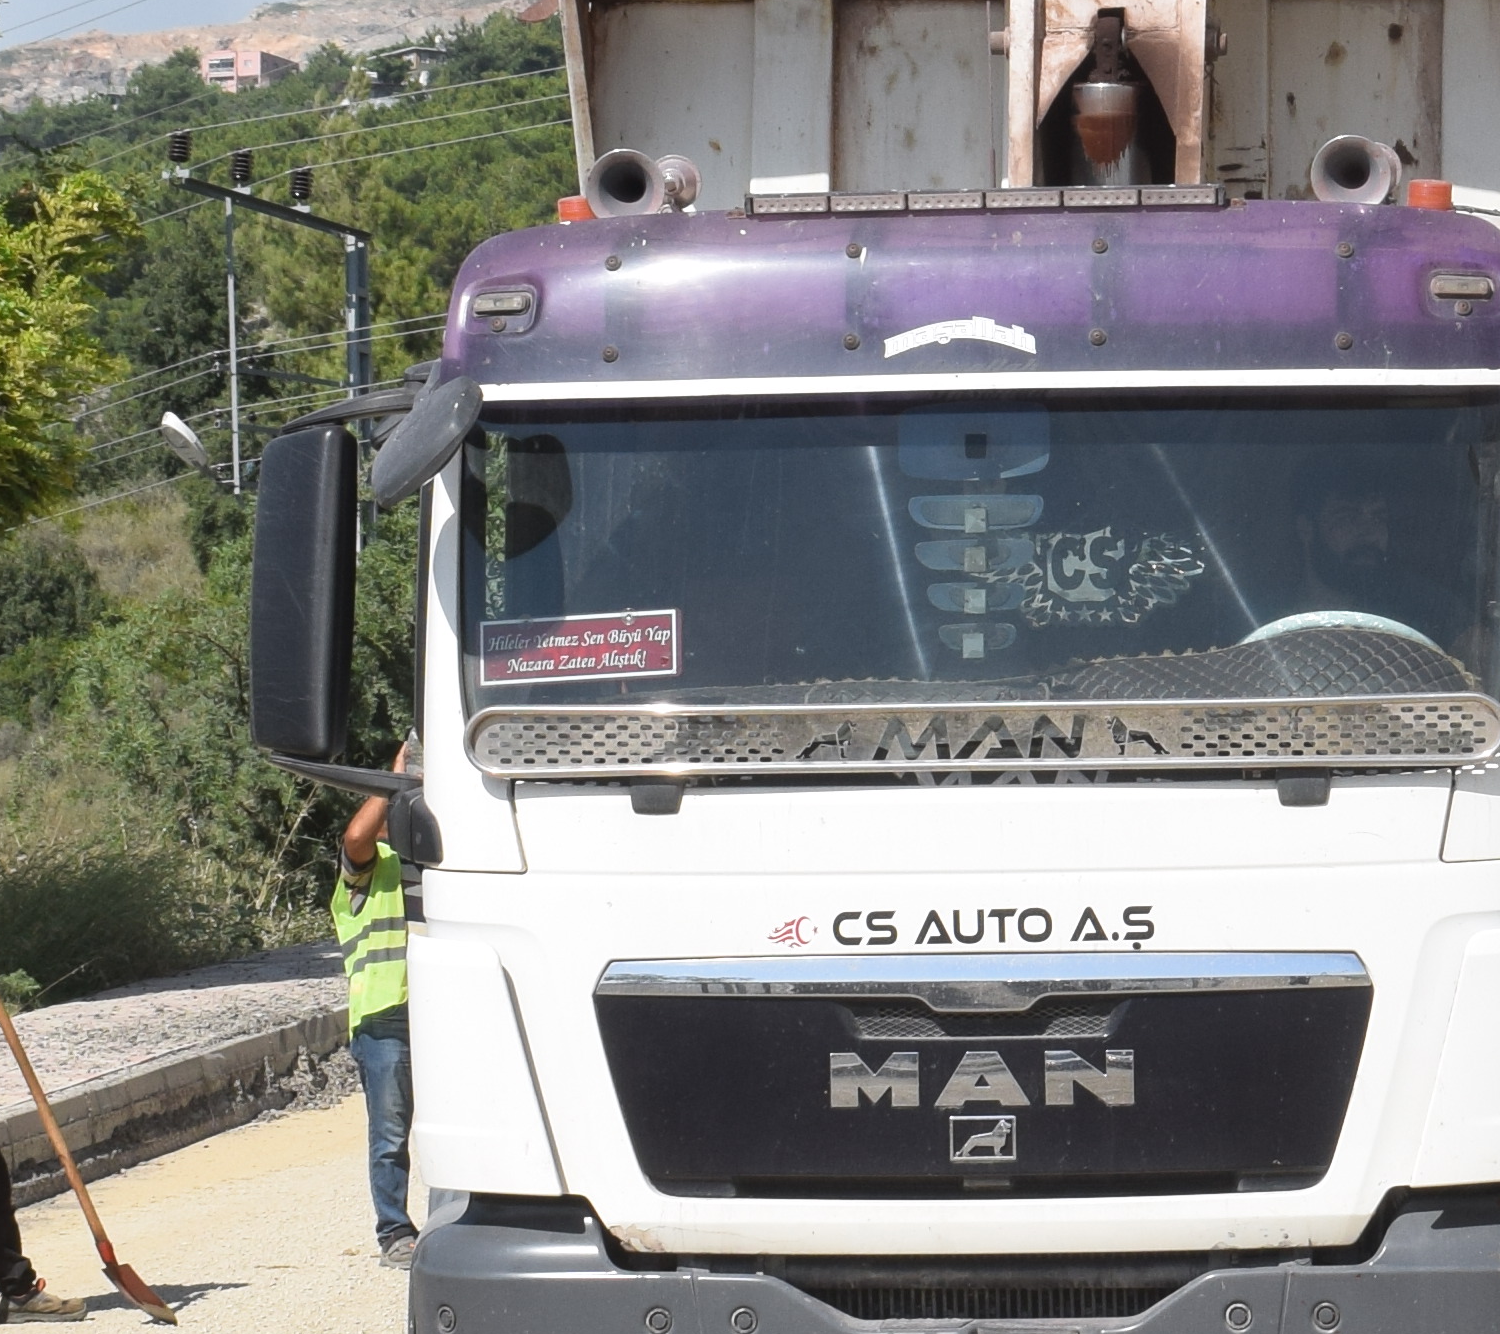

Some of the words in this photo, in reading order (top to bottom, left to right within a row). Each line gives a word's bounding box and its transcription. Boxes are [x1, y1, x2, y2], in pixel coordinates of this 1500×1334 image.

[487, 633, 532, 651] Hileler
[533, 633, 579, 649] Yetmez
[581, 630, 605, 647] Sen
[607, 628, 642, 648] Büyü
[645, 625, 671, 646] Yap
[506, 657, 555, 674] Nazara
[558, 654, 596, 670] Zaten
[872, 714, 1086, 761] MAN
[832, 910, 898, 946] CS
[914, 907, 1053, 945] AUTO
[1069, 905, 1156, 950] A.Ş
[830, 1049, 1136, 1108] MAN
